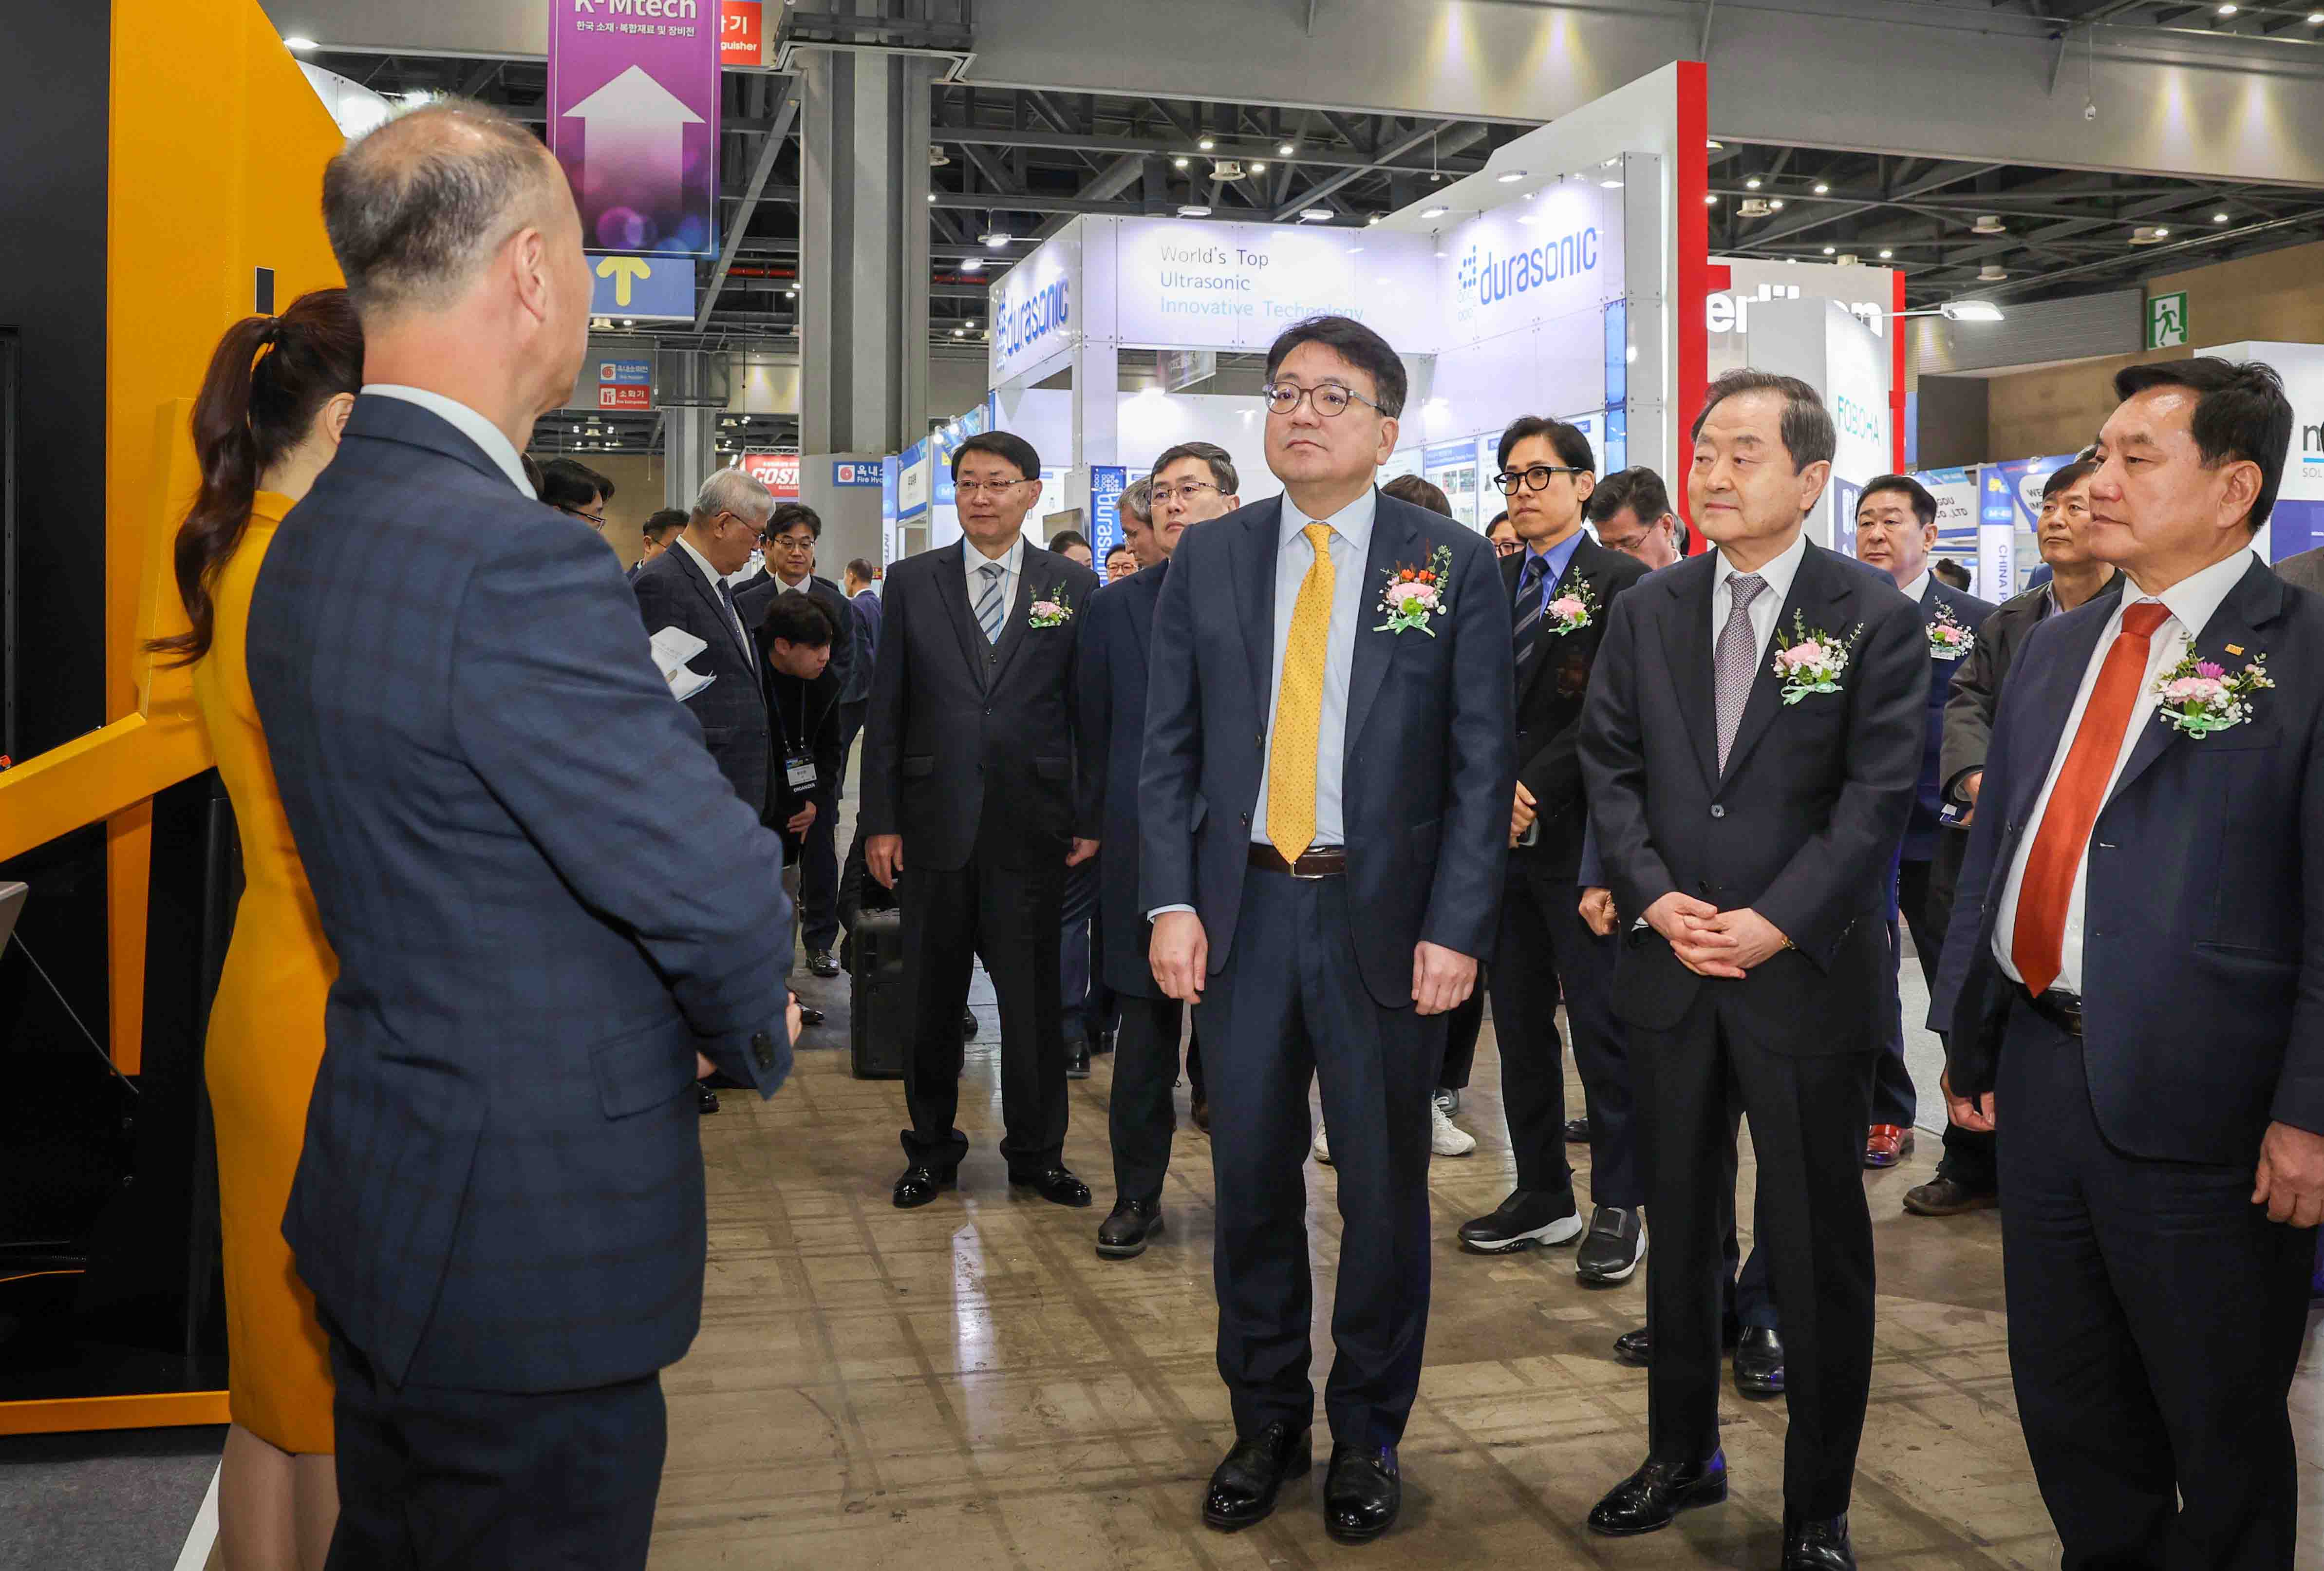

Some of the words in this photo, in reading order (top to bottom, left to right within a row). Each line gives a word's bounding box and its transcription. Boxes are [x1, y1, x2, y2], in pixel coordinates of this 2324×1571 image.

[577, 21, 594, 31] 한국
[669, 26, 694, 37] 장비전
[1161, 245, 1226, 265] World's
[1237, 249, 1269, 269] Top
[1481, 227, 1597, 304] durasonic
[1161, 271, 1251, 291] Ultrasonic
[1007, 278, 1068, 357] durasonic
[1161, 296, 1253, 316] Innovative
[1999, 545, 2007, 588] CHINA
